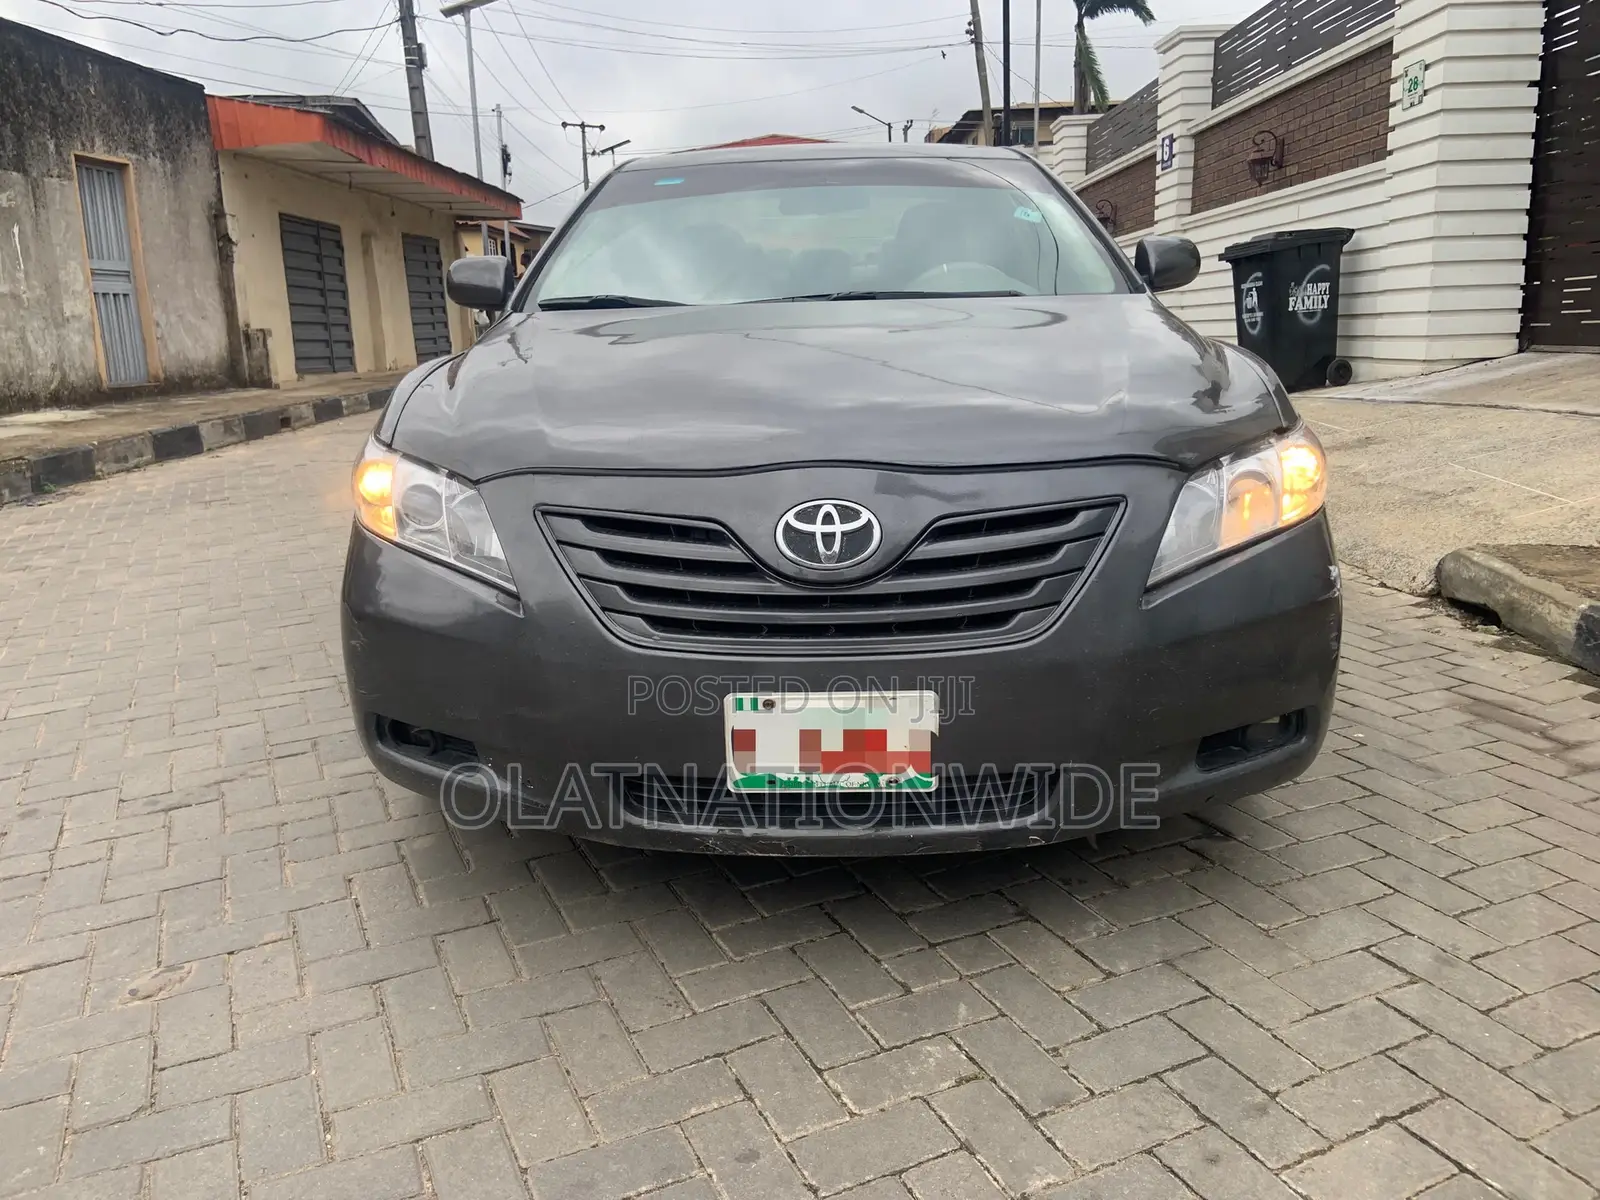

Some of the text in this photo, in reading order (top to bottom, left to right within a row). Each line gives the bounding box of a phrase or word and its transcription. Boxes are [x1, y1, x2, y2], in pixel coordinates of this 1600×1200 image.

[1408, 76, 1419, 93] 28
[1163, 138, 1170, 161] 6
[1306, 282, 1331, 296] HAPPY
[1288, 294, 1330, 312] FAMILY
